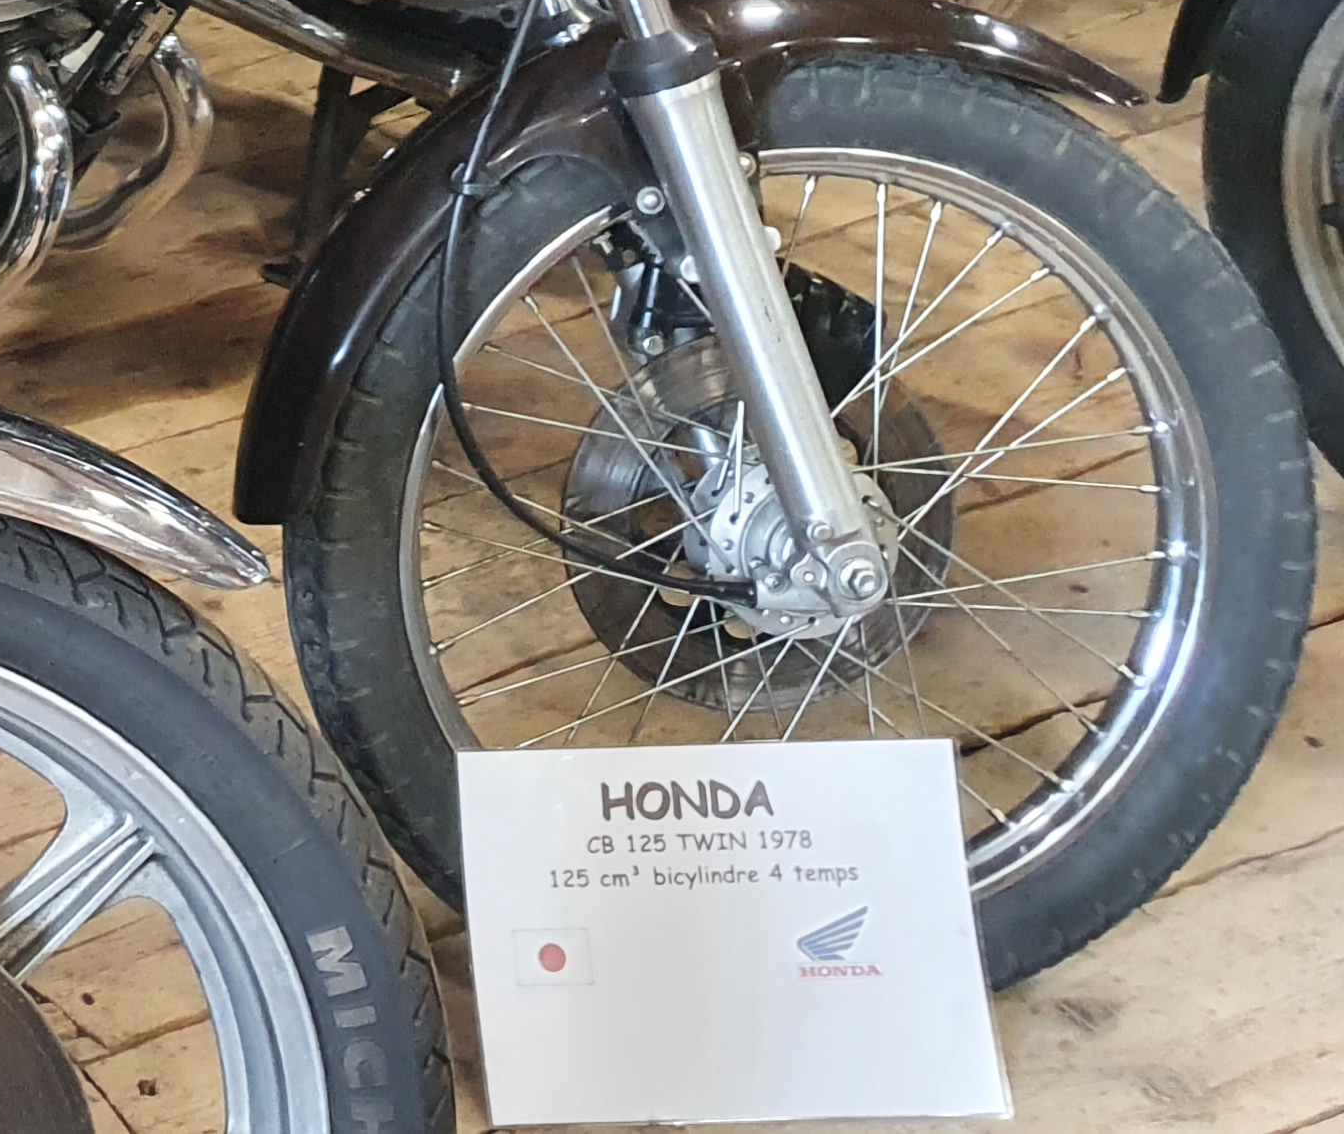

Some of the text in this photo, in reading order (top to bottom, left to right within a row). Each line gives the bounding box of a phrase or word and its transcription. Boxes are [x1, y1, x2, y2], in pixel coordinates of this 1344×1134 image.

[600, 779, 775, 822] HONDA
[586, 829, 813, 854] CB 125 TWIN 1978
[549, 869, 590, 888] 125
[652, 866, 760, 890] bicylindre
[768, 864, 783, 882] 4
[792, 864, 860, 888] temps
[799, 964, 882, 978] HONDA
